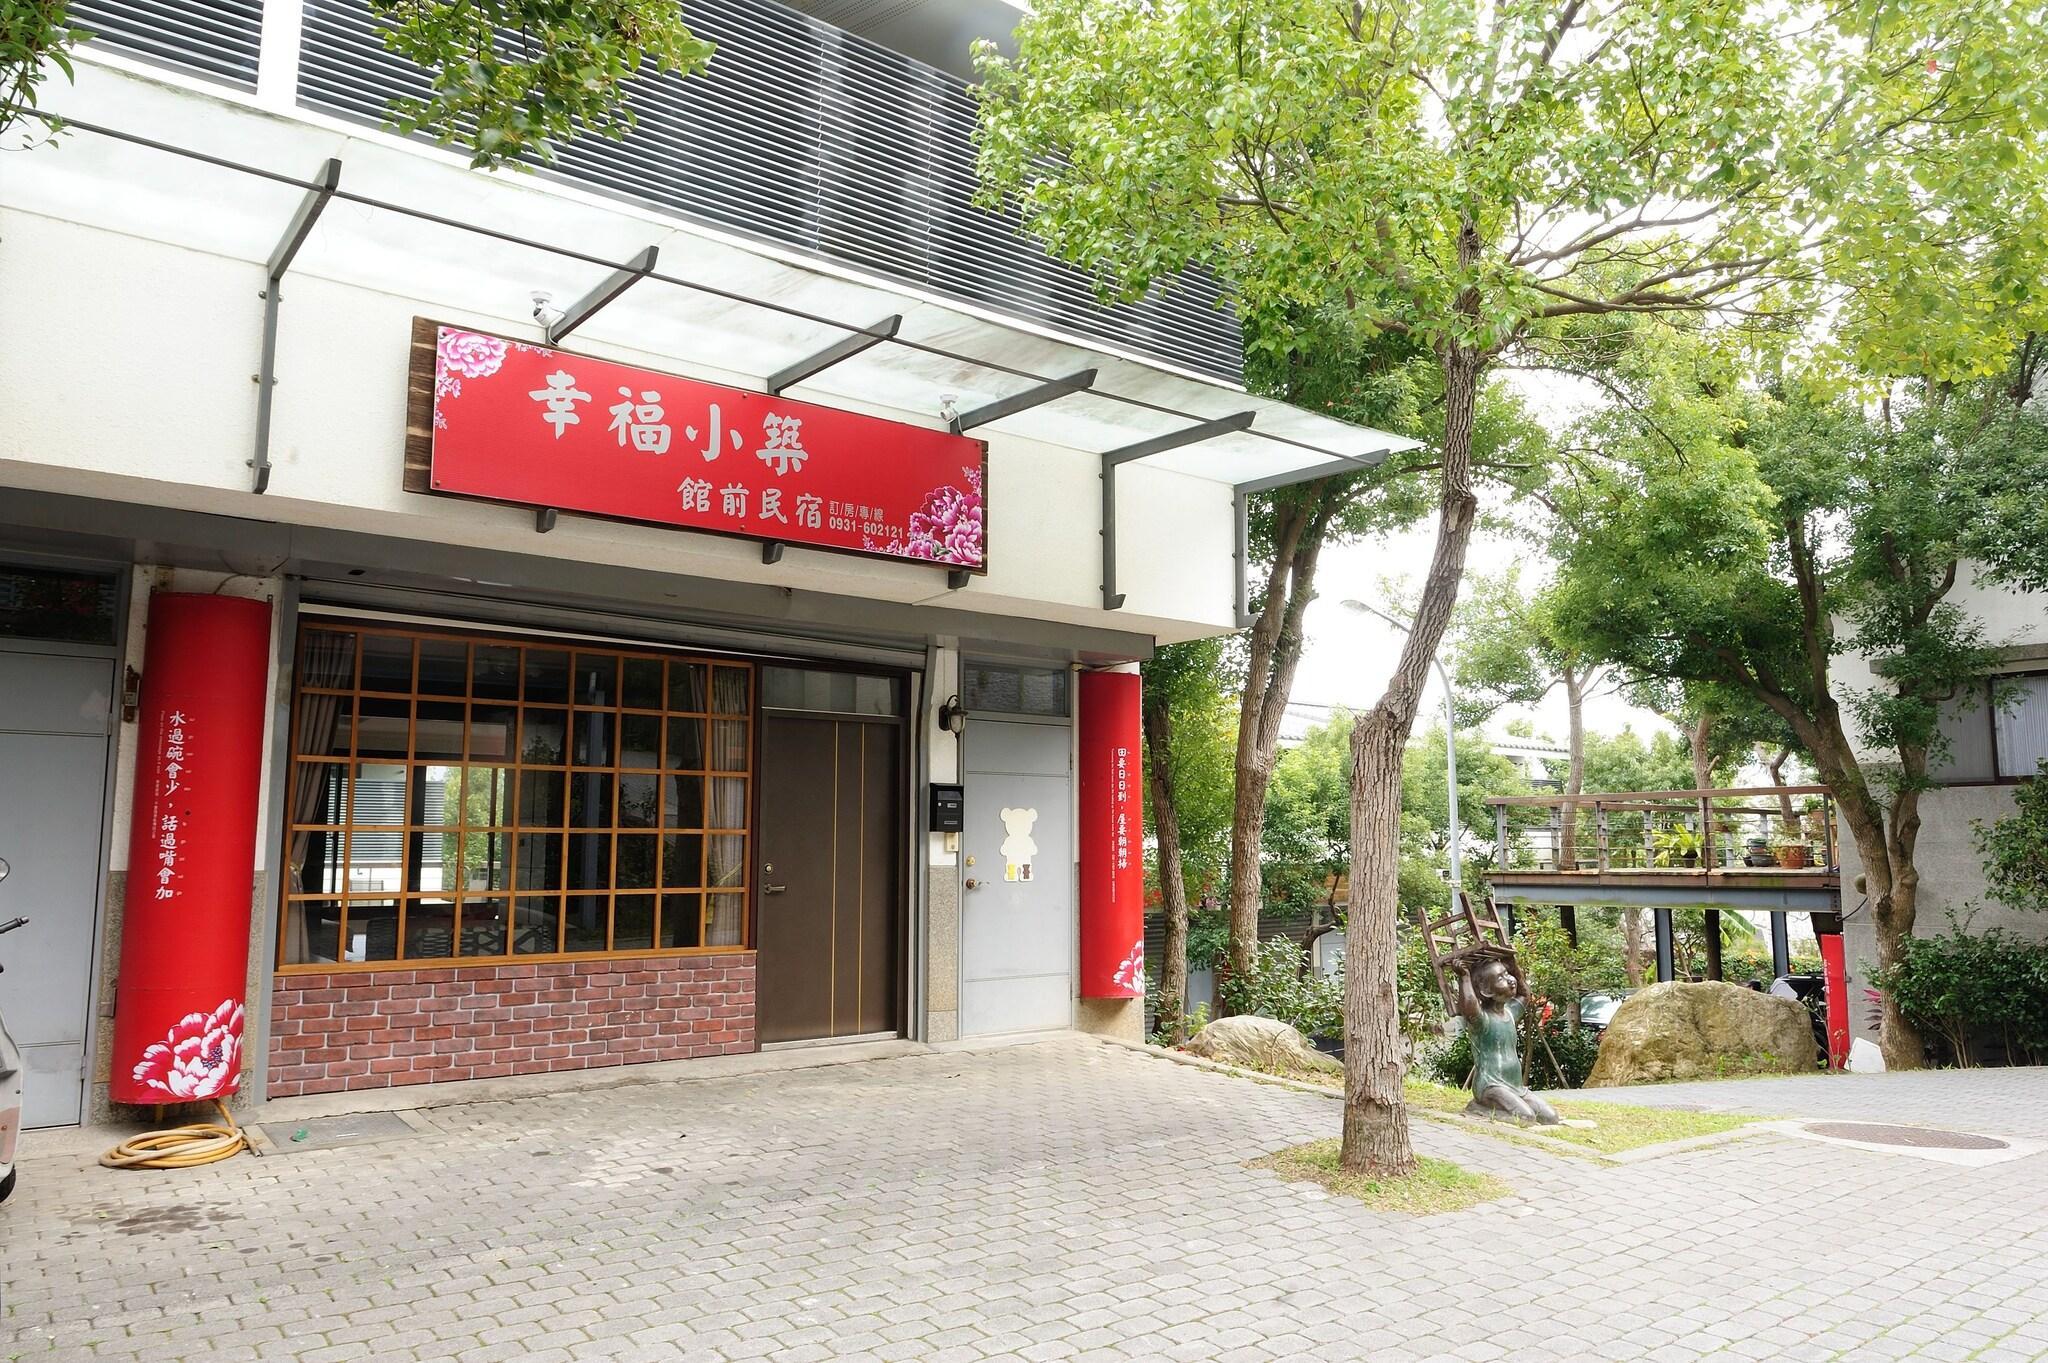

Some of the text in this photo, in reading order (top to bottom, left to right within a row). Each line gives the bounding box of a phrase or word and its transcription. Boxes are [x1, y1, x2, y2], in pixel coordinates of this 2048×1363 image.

[528, 369, 809, 477] 幸福小築
[677, 476, 823, 529] 館前民宿
[829, 516, 903, 539] 0931-602121
